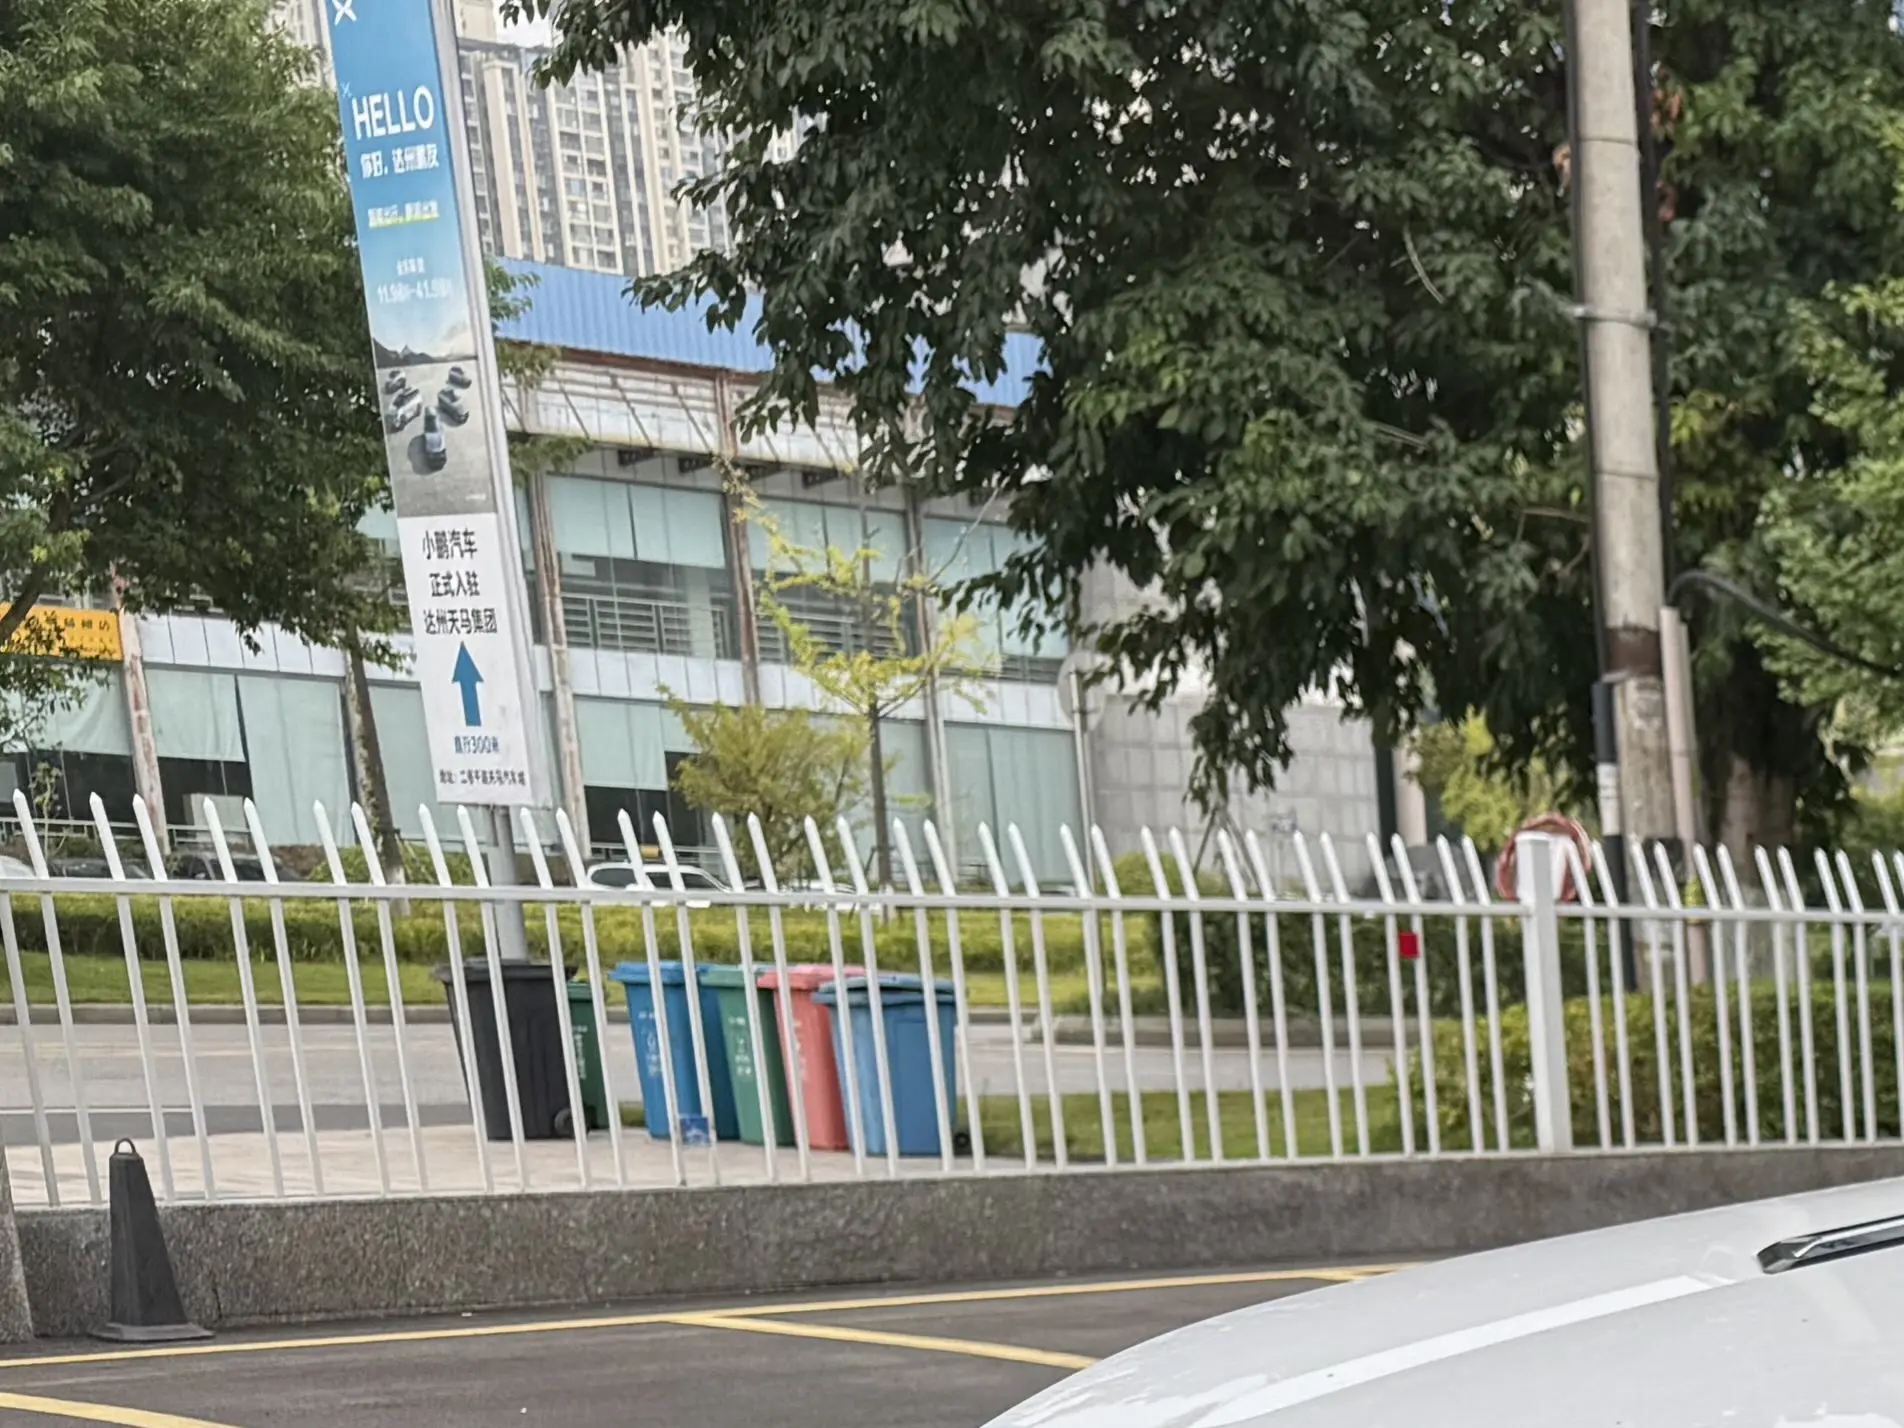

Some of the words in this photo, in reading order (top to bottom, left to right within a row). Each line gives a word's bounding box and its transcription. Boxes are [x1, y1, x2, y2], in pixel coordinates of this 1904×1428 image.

[351, 85, 435, 141] HELLO
[422, 528, 478, 560] 小鹏汽车
[429, 570, 480, 598] 正式入驻
[422, 607, 498, 635] 达州天马集团
